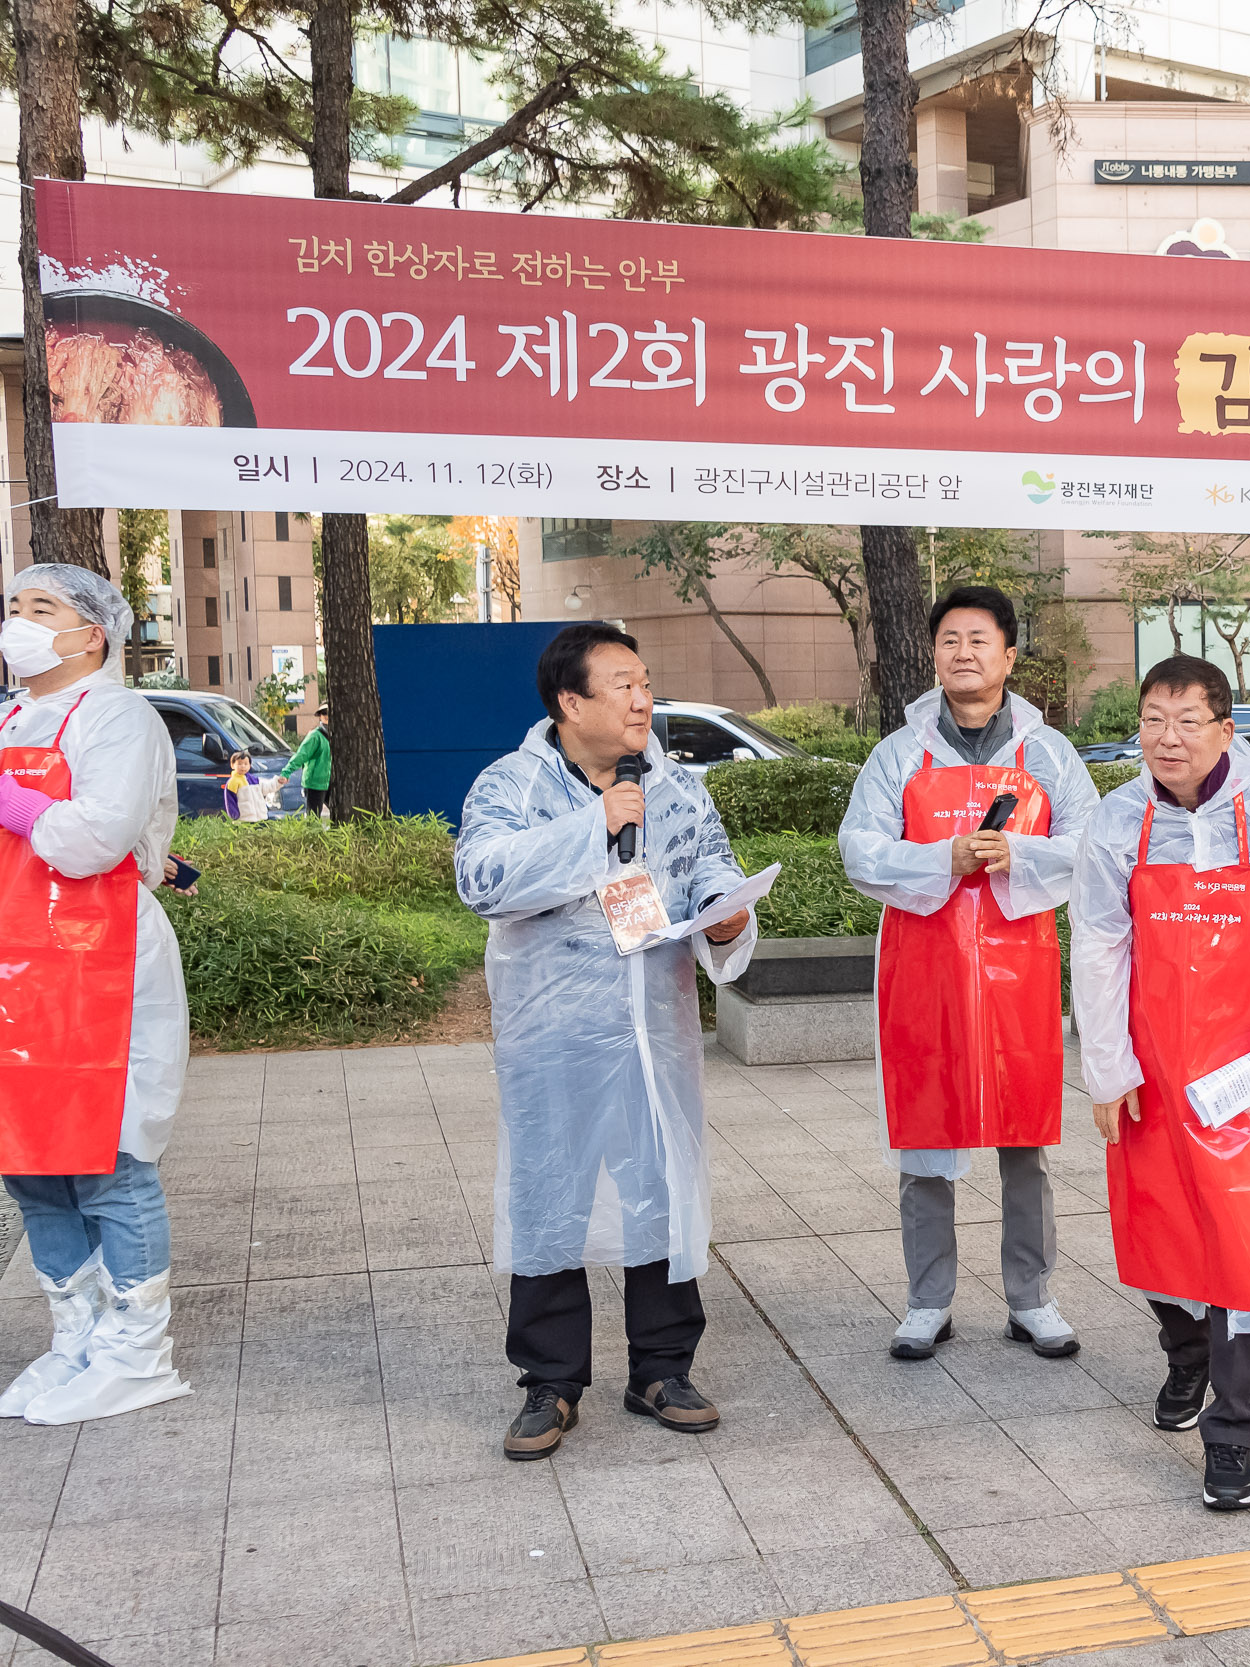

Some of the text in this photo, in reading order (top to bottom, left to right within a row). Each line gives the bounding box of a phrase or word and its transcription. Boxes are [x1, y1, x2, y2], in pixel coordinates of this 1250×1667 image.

[1191, 165, 1238, 179] 가맹본부
[287, 235, 685, 294] 김치 한상자로 전하는 안부
[286, 306, 477, 383] 2024
[496, 310, 707, 407] 제2회
[739, 322, 896, 414] 광진
[920, 331, 1146, 424] 사랑의
[231, 453, 963, 502] 일시 2024. 11. 12(화) 장소 광진구시설관리공단 앞
[1060, 480, 1154, 501] 광진복지재단
[1061, 498, 1153, 508] Gwangjin Welfare Foundation
[1207, 882, 1246, 892] KB 국민은행
[1183, 903, 1201, 911] 2024
[1149, 912, 1168, 921] 제2회
[1169, 912, 1183, 922] 광진
[1184, 913, 1210, 923] 사랑의
